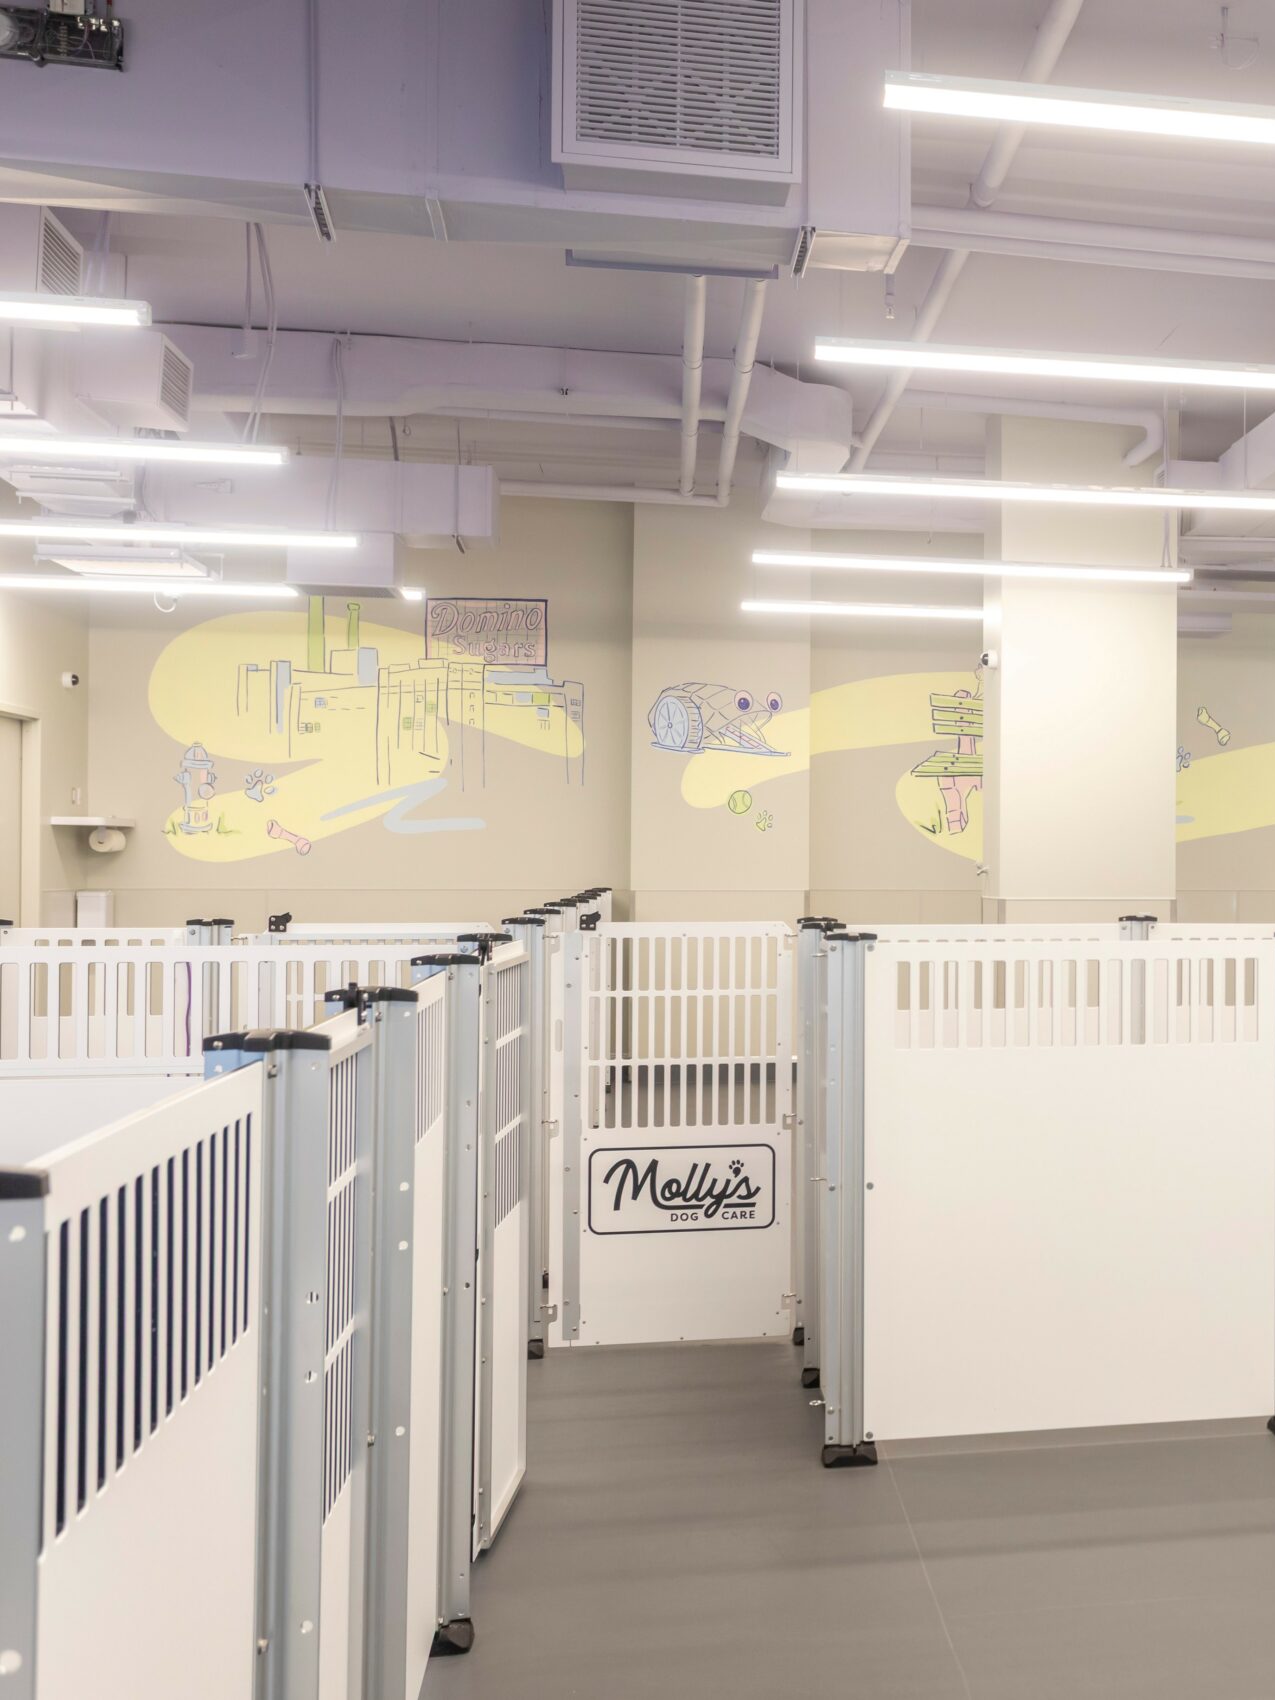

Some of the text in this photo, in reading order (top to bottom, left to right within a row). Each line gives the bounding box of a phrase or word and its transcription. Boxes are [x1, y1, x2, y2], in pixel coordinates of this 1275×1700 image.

[431, 602, 543, 636] Domino
[453, 635, 537, 663] Sugars
[603, 1158, 761, 1219] Molly's
[670, 1210, 756, 1222] DOG CARE
